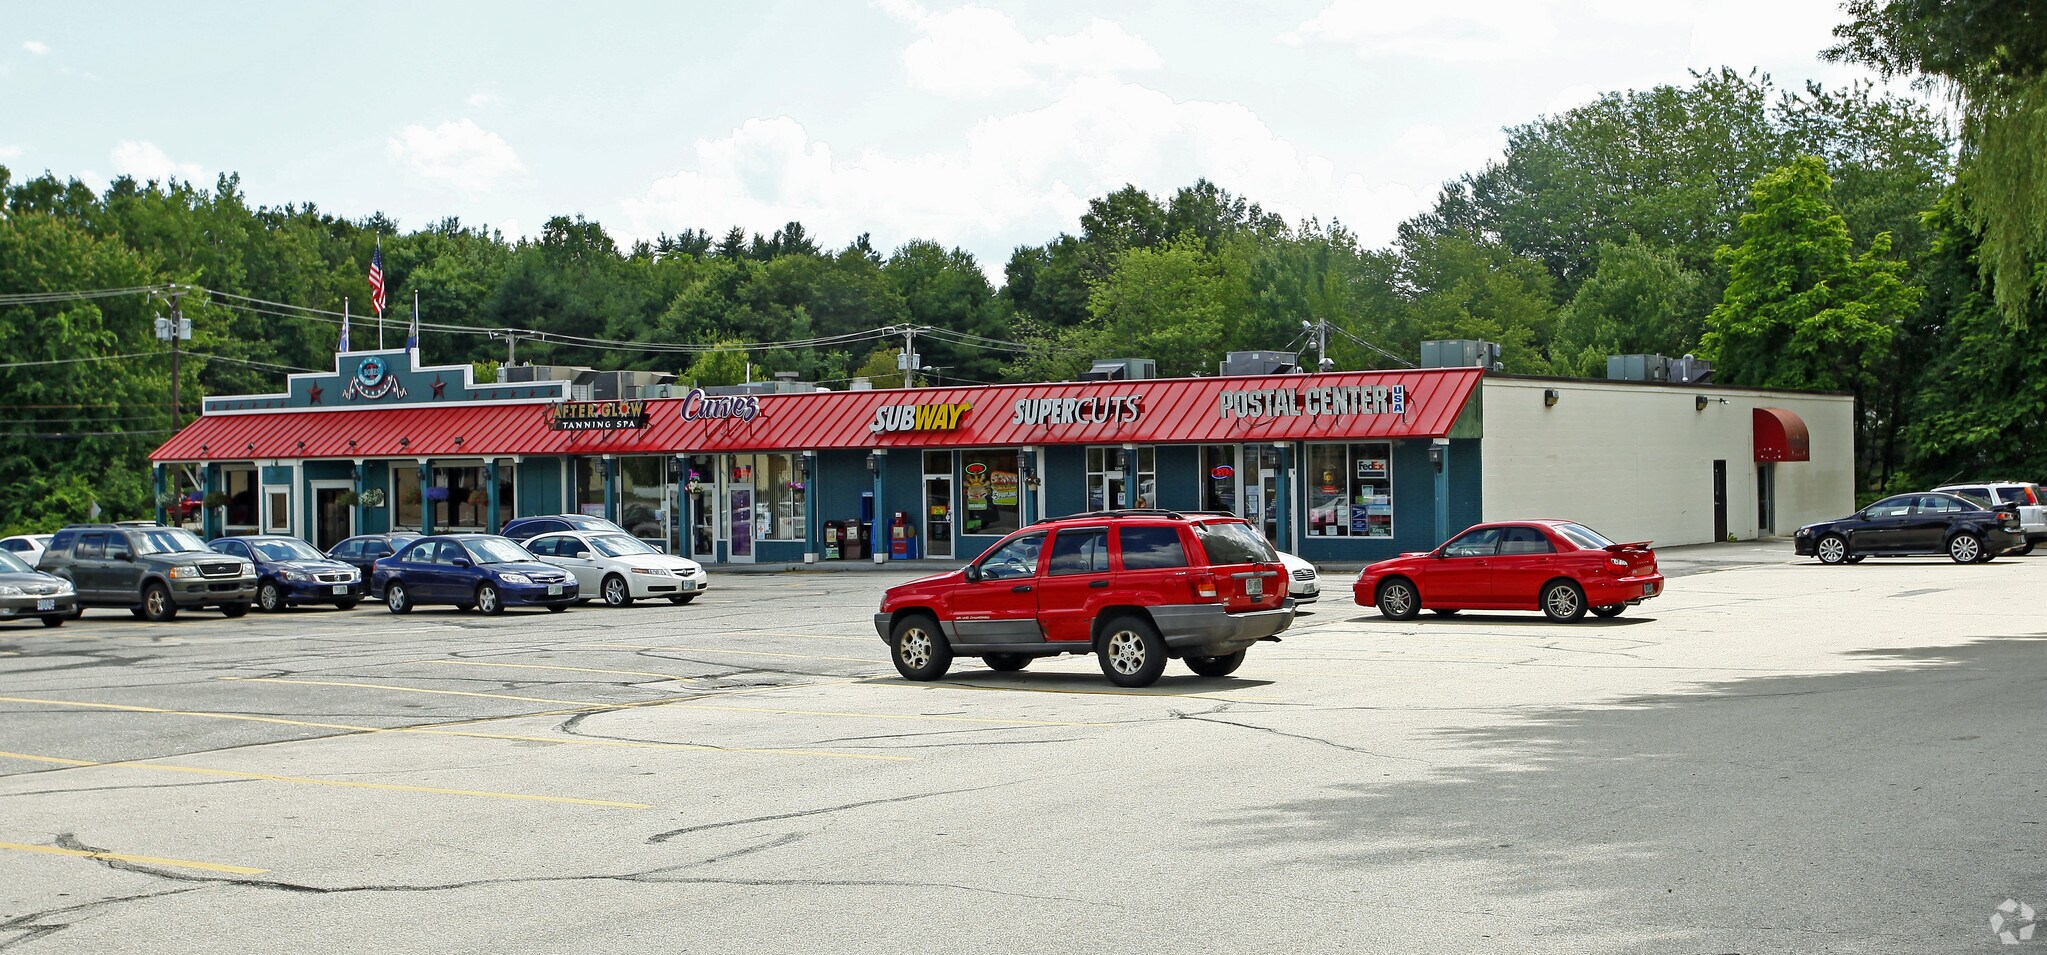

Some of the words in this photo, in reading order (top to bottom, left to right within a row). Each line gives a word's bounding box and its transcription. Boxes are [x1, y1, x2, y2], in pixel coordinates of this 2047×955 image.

[553, 402, 596, 419] AFTER
[602, 399, 643, 418] GLOW
[681, 388, 760, 422] Curves
[1013, 395, 1141, 425] SUPERCUTS
[1219, 388, 1302, 419] POSTAL
[1305, 385, 1390, 416] CENTER
[1393, 386, 1403, 412] USA
[563, 421, 611, 429] TANNING
[617, 420, 636, 428] SPA
[869, 401, 973, 432] SUBWAY
[1211, 467, 1233, 477] OPEN
[1359, 461, 1384, 470] FedEx
